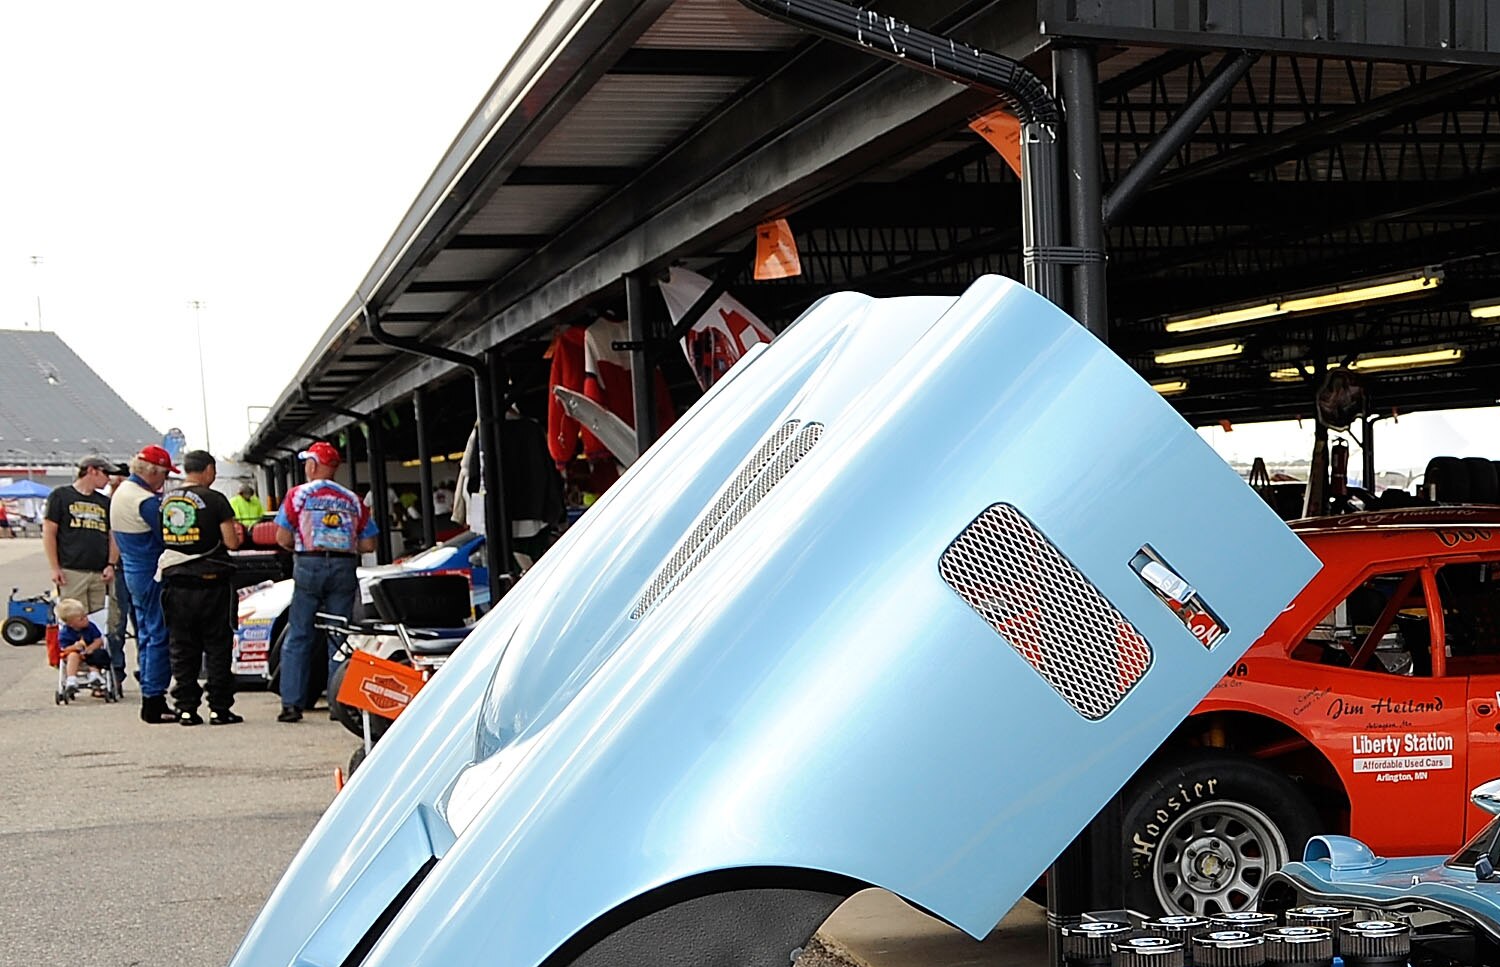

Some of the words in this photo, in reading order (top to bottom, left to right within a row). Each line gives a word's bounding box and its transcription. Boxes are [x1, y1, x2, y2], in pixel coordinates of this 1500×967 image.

[1327, 698, 1364, 719] Jim
[1372, 697, 1443, 714] Heiland
[1352, 735, 1400, 756] Liberty
[1404, 732, 1453, 752] Station
[1362, 759, 1403, 770] Affordable
[1404, 759, 1424, 769] Used
[1426, 758, 1444, 768] Cars
[1376, 773, 1413, 783] Arlington,
[1414, 772, 1428, 780] MN
[1132, 778, 1218, 864] Hoosier
